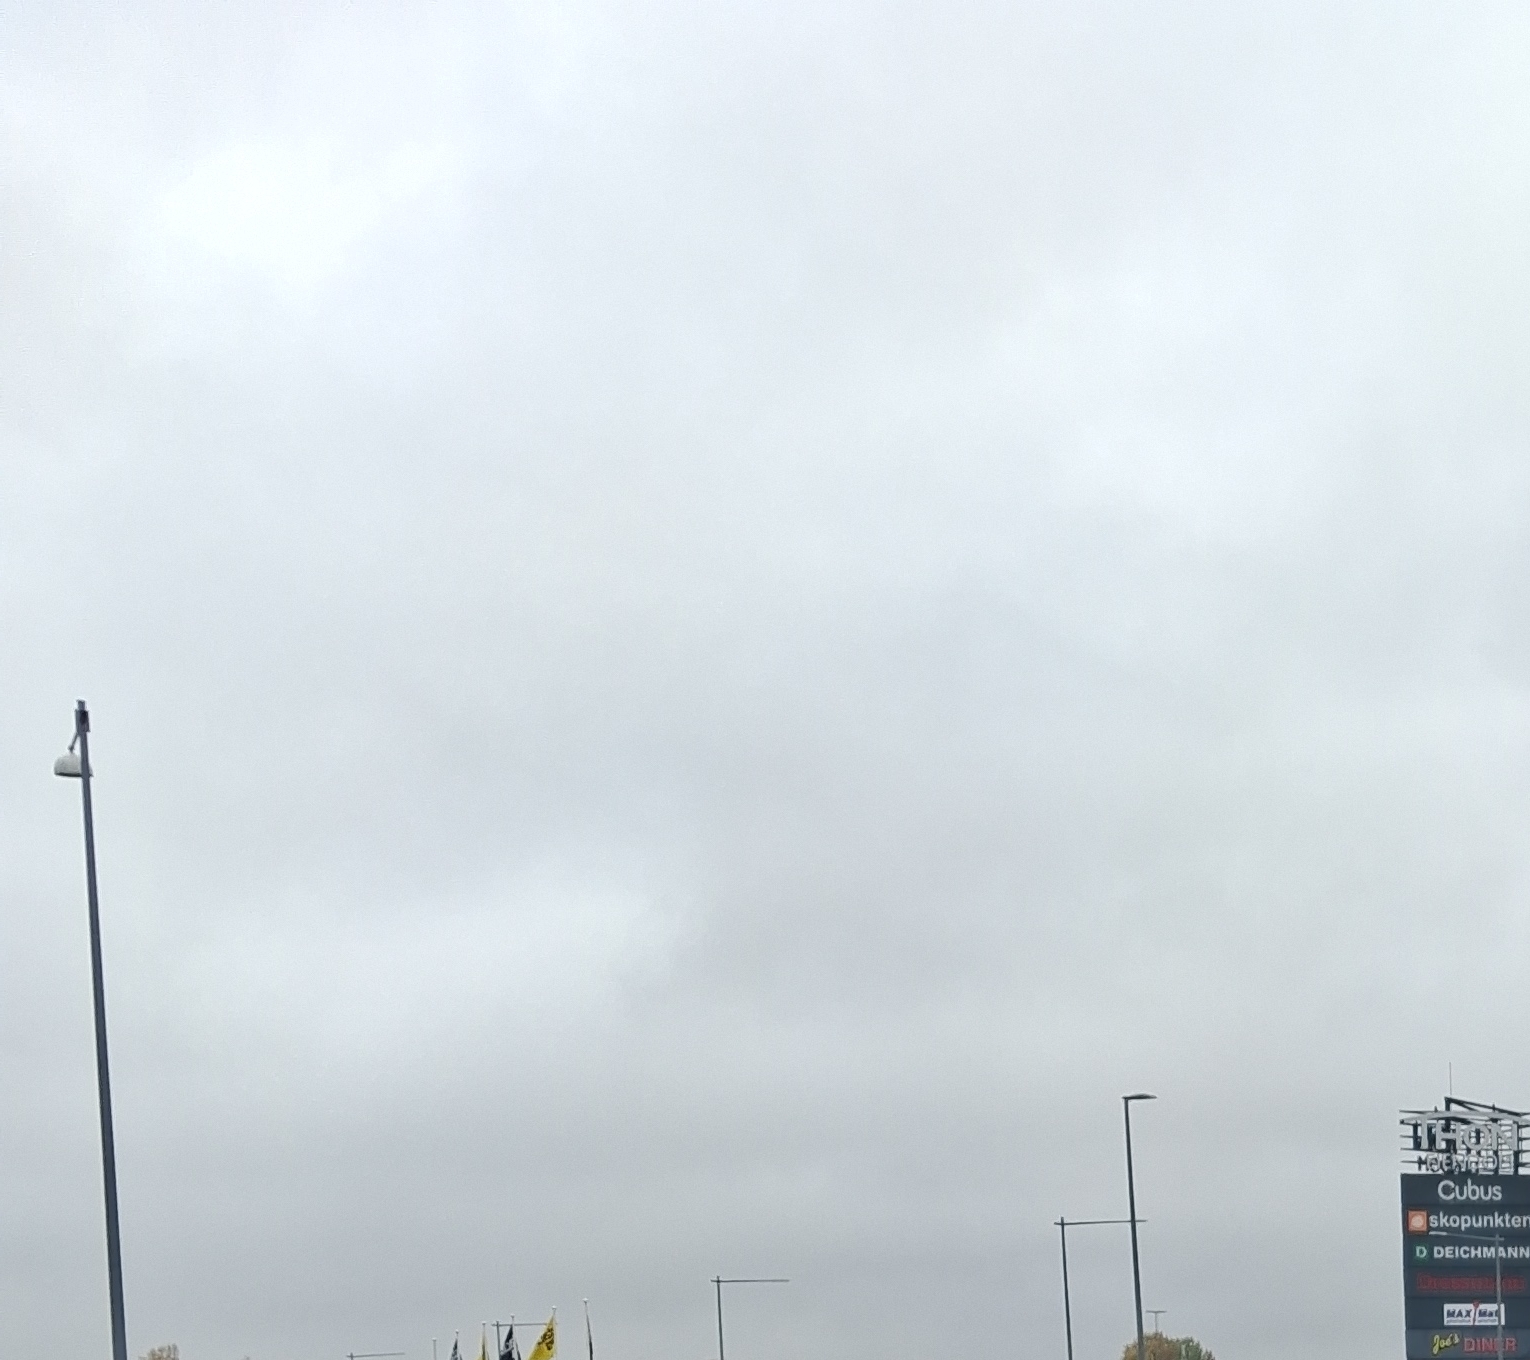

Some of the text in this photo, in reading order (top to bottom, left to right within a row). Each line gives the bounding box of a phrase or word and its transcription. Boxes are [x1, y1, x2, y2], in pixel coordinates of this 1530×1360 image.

[1438, 1178, 1502, 1200] Cubus
[1433, 1246, 1530, 1258] DEICHMANN
[1432, 1333, 1459, 1354] Joe's
